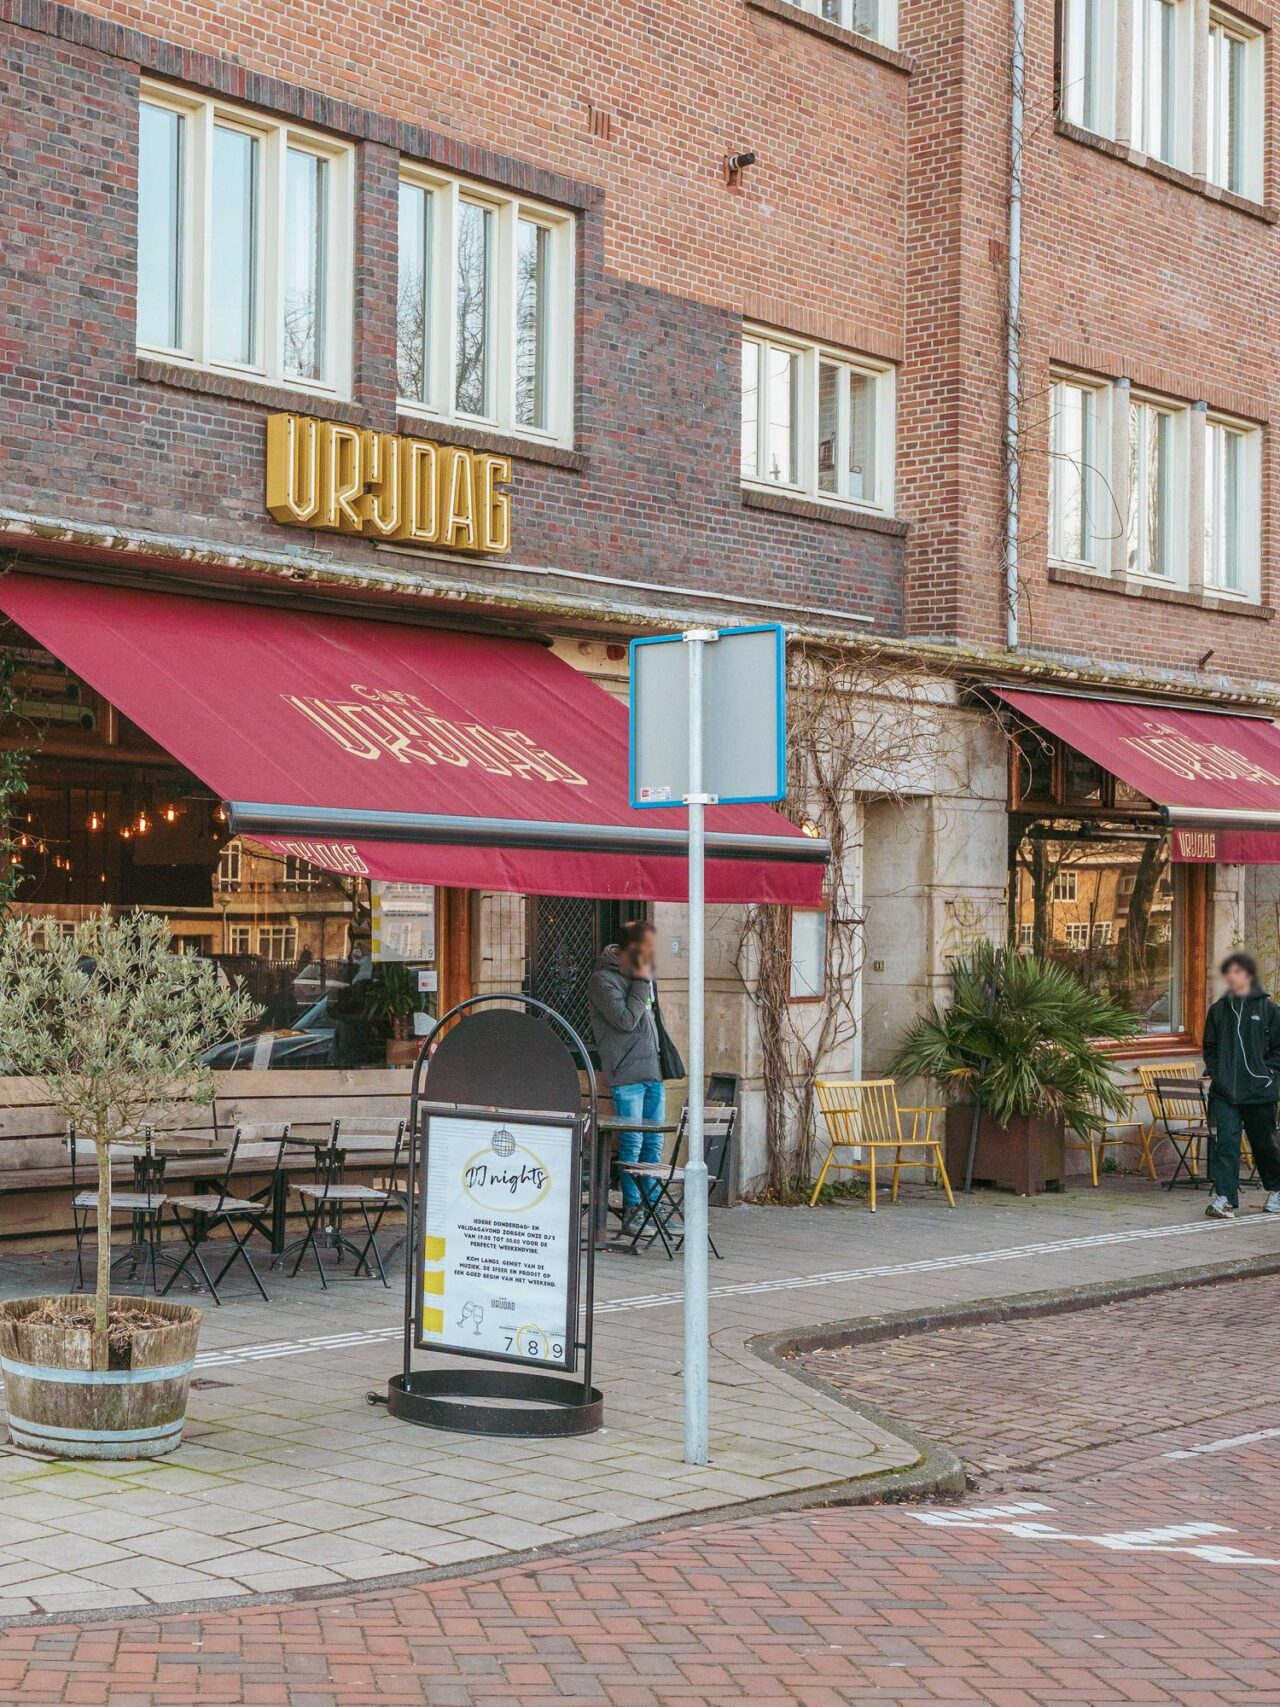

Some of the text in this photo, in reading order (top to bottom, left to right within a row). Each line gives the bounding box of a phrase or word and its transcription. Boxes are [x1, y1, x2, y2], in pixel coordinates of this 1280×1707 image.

[490, 1165, 548, 1194] nights
[457, 1224, 500, 1234] VRIJDAGAVOND
[470, 1241, 497, 1249] PERFECTE
[504, 1336, 563, 1358] 7 8 9
